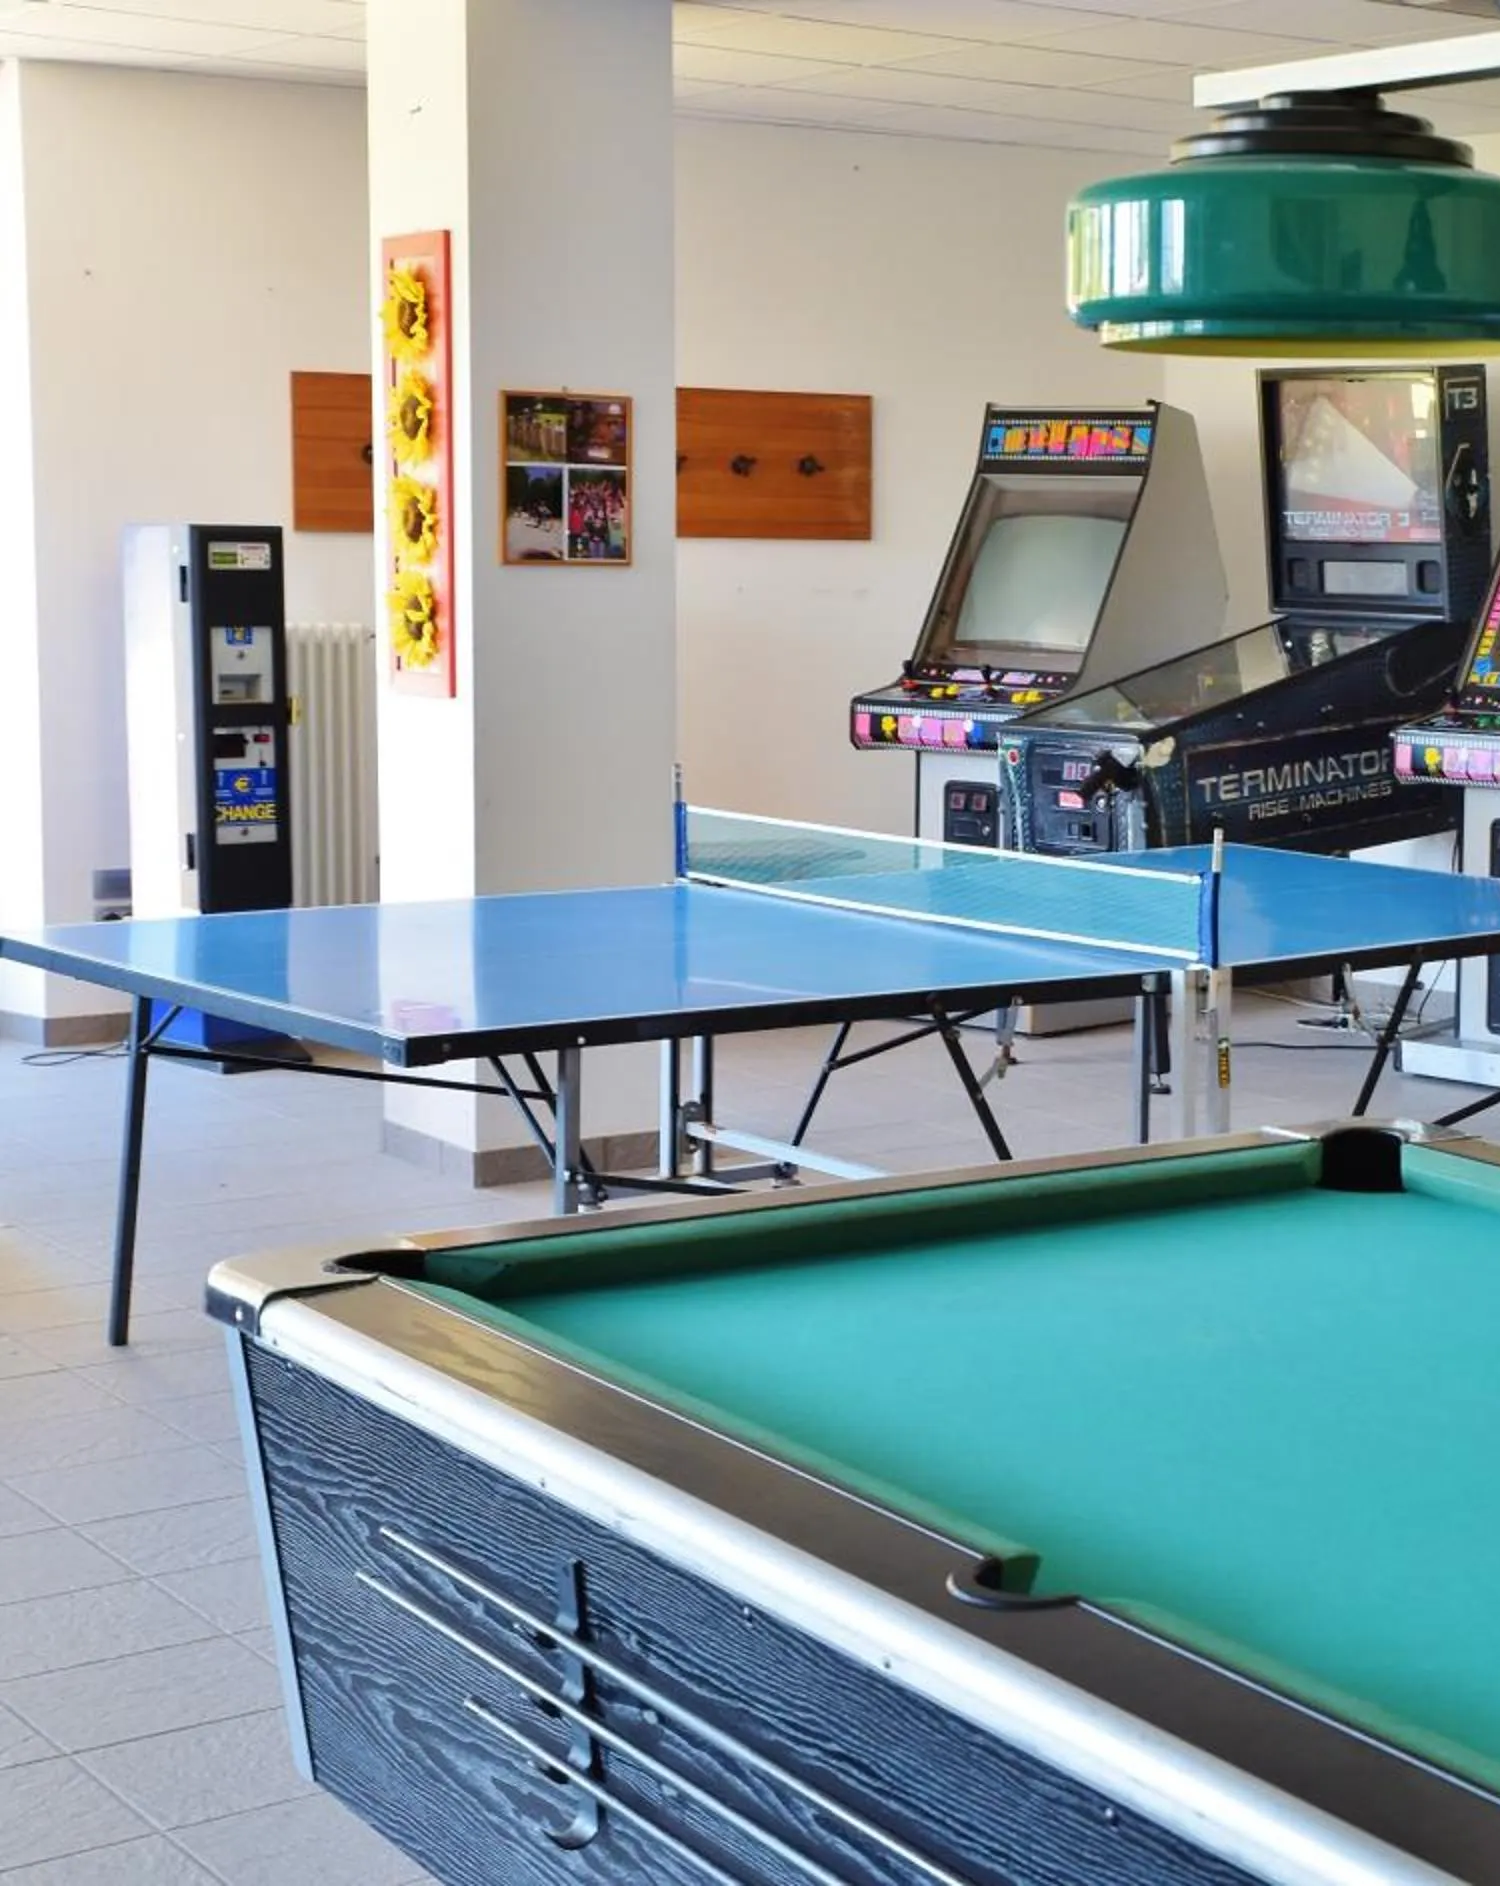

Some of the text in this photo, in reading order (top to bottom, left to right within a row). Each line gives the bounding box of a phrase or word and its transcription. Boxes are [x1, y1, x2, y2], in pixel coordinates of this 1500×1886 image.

[1449, 387, 1478, 410] T3
[215, 803, 277, 821] CHANGE
[1248, 799, 1290, 821] RISE
